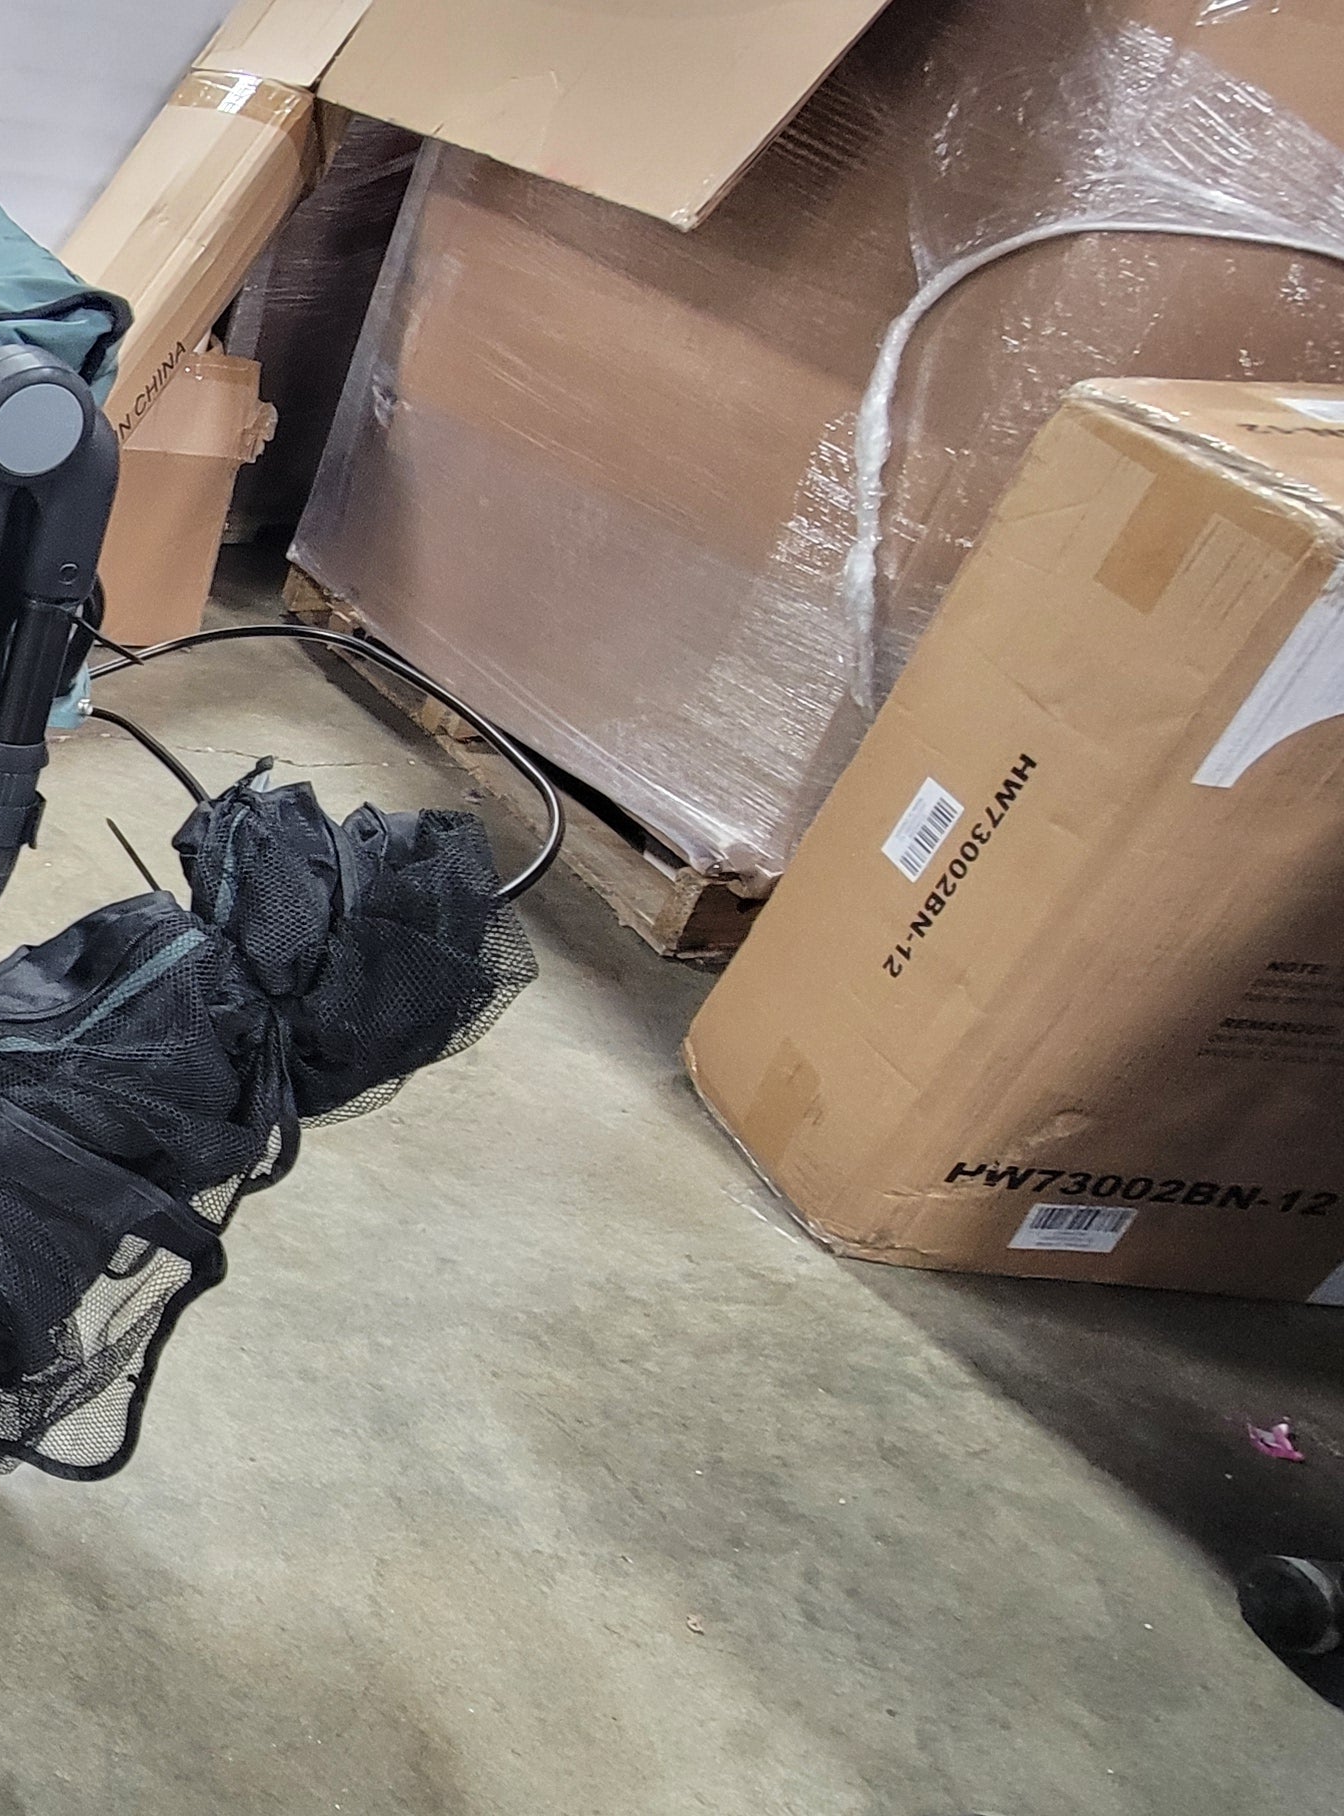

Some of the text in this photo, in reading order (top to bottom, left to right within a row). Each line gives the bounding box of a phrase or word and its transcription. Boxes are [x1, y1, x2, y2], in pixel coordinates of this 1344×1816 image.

[134, 341, 186, 416] CHINA
[881, 753, 1038, 979] HW73002BN-12
[943, 1160, 1340, 1217] HW73002BN-12
